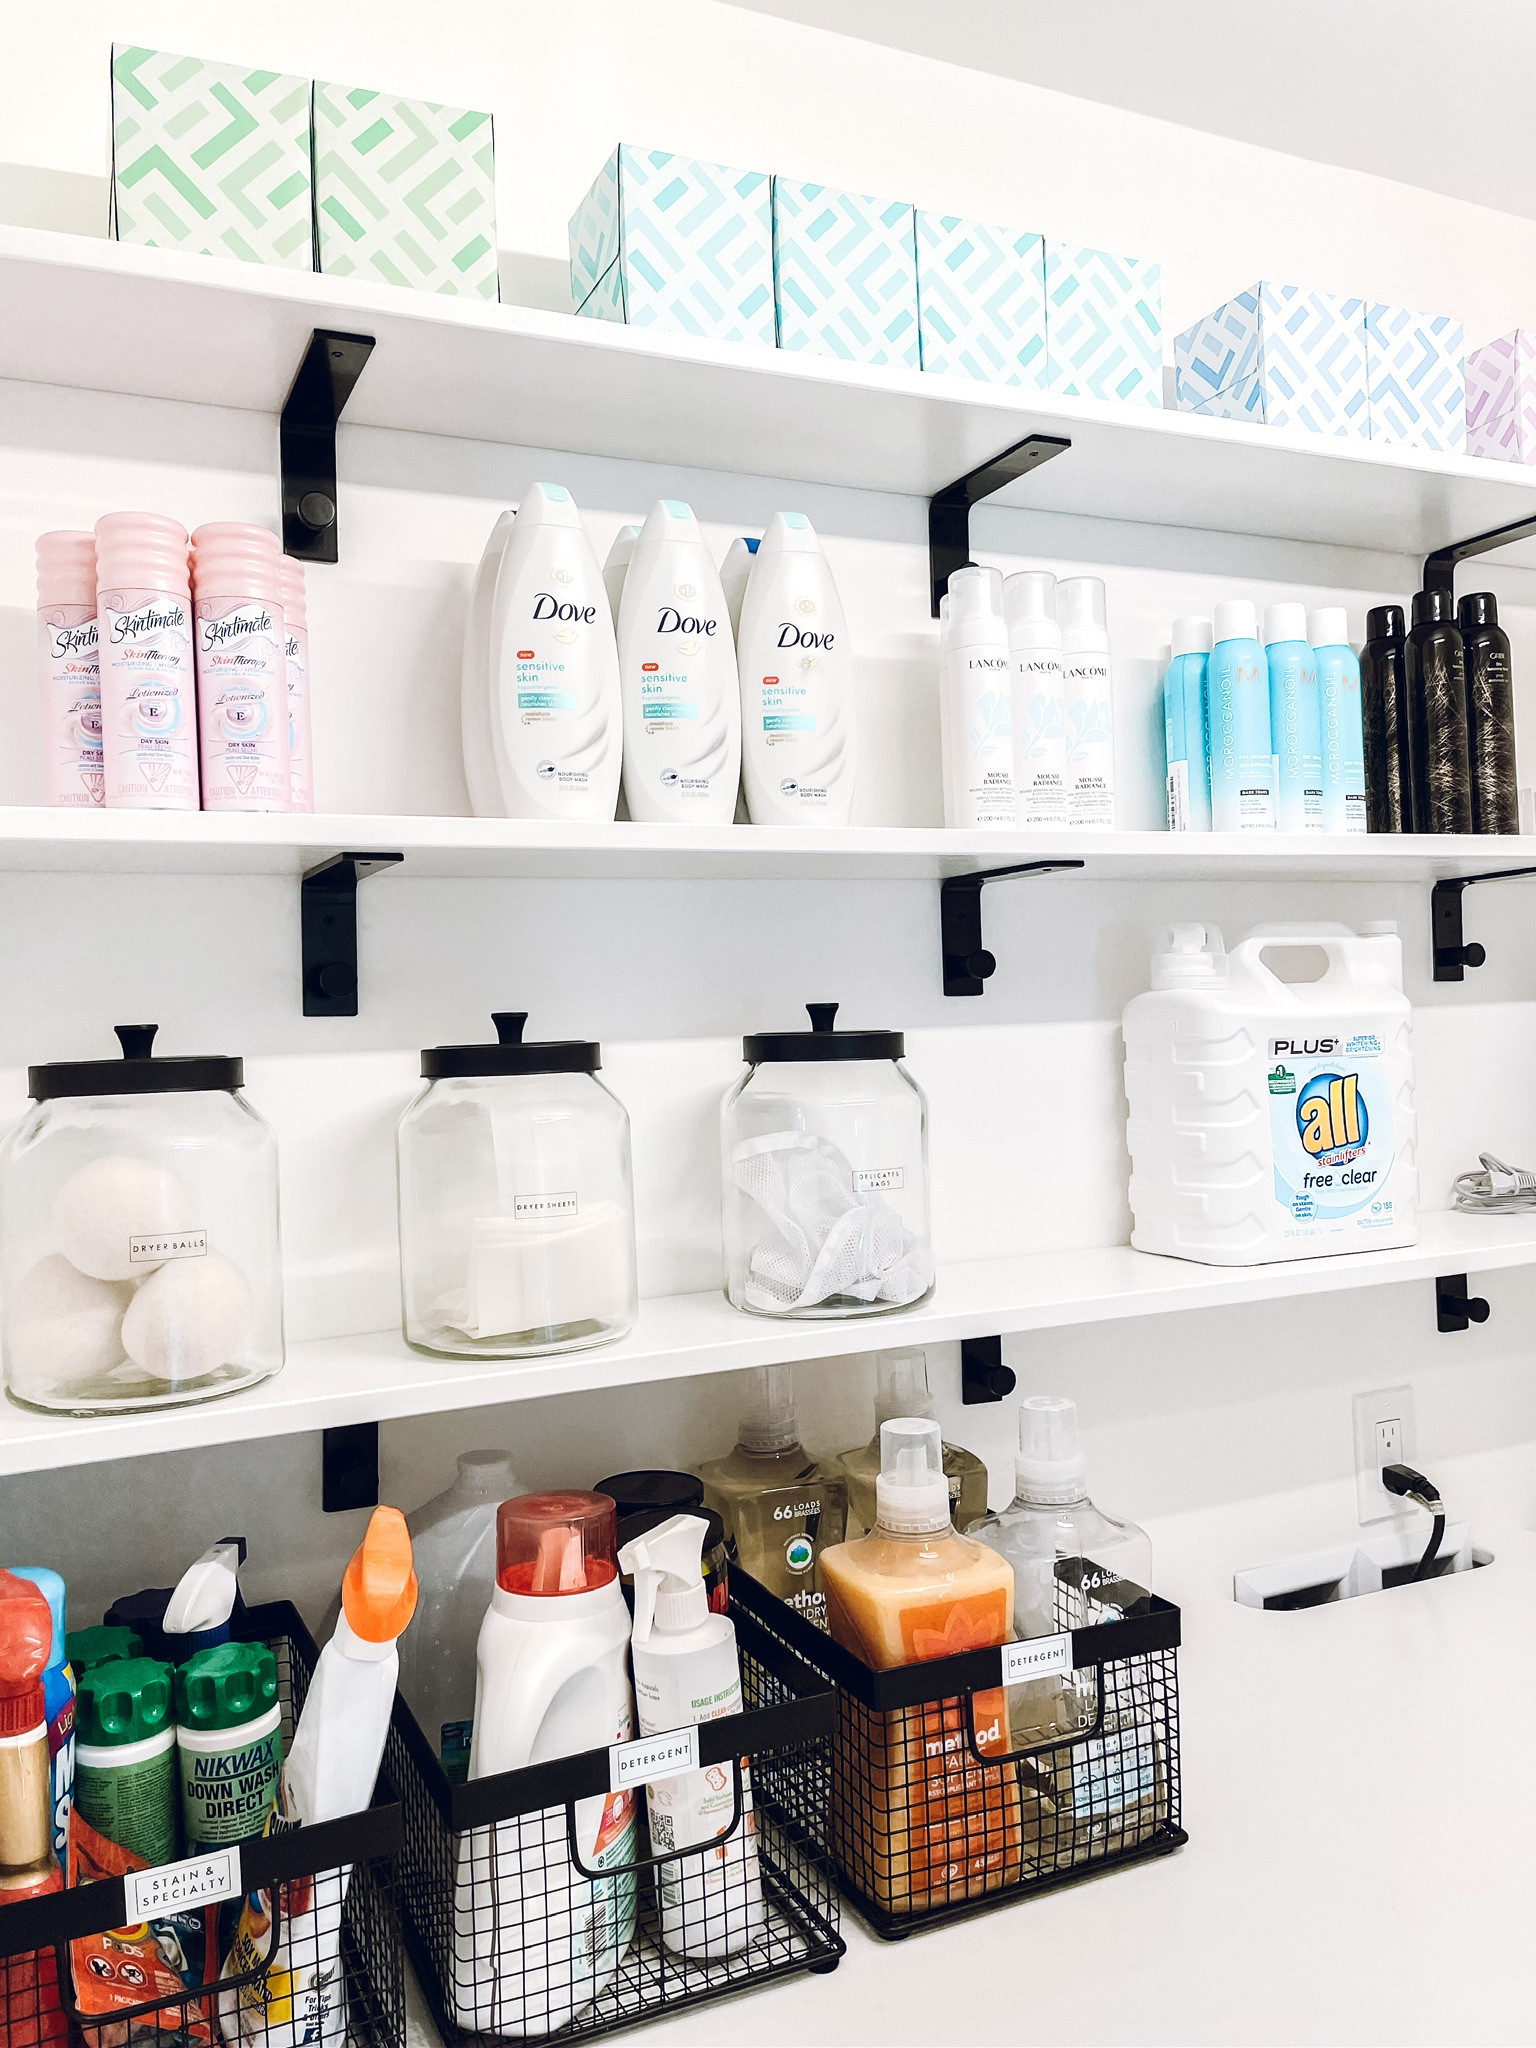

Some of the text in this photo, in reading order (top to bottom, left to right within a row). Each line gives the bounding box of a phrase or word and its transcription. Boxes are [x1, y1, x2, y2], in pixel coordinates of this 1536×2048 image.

[532, 592, 596, 625] Dove
[110, 606, 184, 644] Skintimate
[202, 610, 273, 652] Skintimate
[657, 606, 717, 637] Dove
[51, 625, 98, 658] Skinti
[777, 622, 835, 651] Dove
[516, 660, 566, 672] sensitive
[516, 672, 539, 682] skin
[641, 672, 688, 683] sensitive
[641, 684, 663, 694] skin
[762, 686, 806, 696] sensitive
[68, 701, 102, 713] Lotion
[762, 696, 783, 706] skin
[149, 707, 158, 717] E
[236, 711, 246, 721] E
[1221, 663, 1235, 780] MOROCCANOIL
[1285, 663, 1299, 780] MOROCCANOIL
[91, 720, 100, 729] E
[1325, 672, 1341, 785] MOROCCANOIL
[1299, 1073, 1360, 1154] all
[1318, 1147, 1366, 1168] stainlifters
[859, 1171, 900, 1180] DELICATES
[1303, 1168, 1377, 1189] free clear
[547, 1200, 576, 1208] SHEETS
[133, 1239, 205, 1253] DRYER BALLS
[773, 1500, 821, 1521] 66 LOADS
[1081, 1571, 1101, 1590] 66
[783, 1589, 826, 1610] etho
[1010, 1648, 1064, 1667] DETERGENT
[691, 1695, 713, 1708] USAGE
[711, 1706, 727, 1718] CLEAN
[925, 1718, 1001, 1757] metod
[194, 1737, 274, 1777] NIKWAX
[621, 1745, 689, 1770] DETERGENT
[187, 1760, 279, 1800] DOWN WASH
[205, 1788, 265, 1819] DIRECT
[153, 1866, 214, 1890] STAIN &
[143, 1876, 225, 1907] SPECIALTY
[305, 1996, 317, 2004] For
